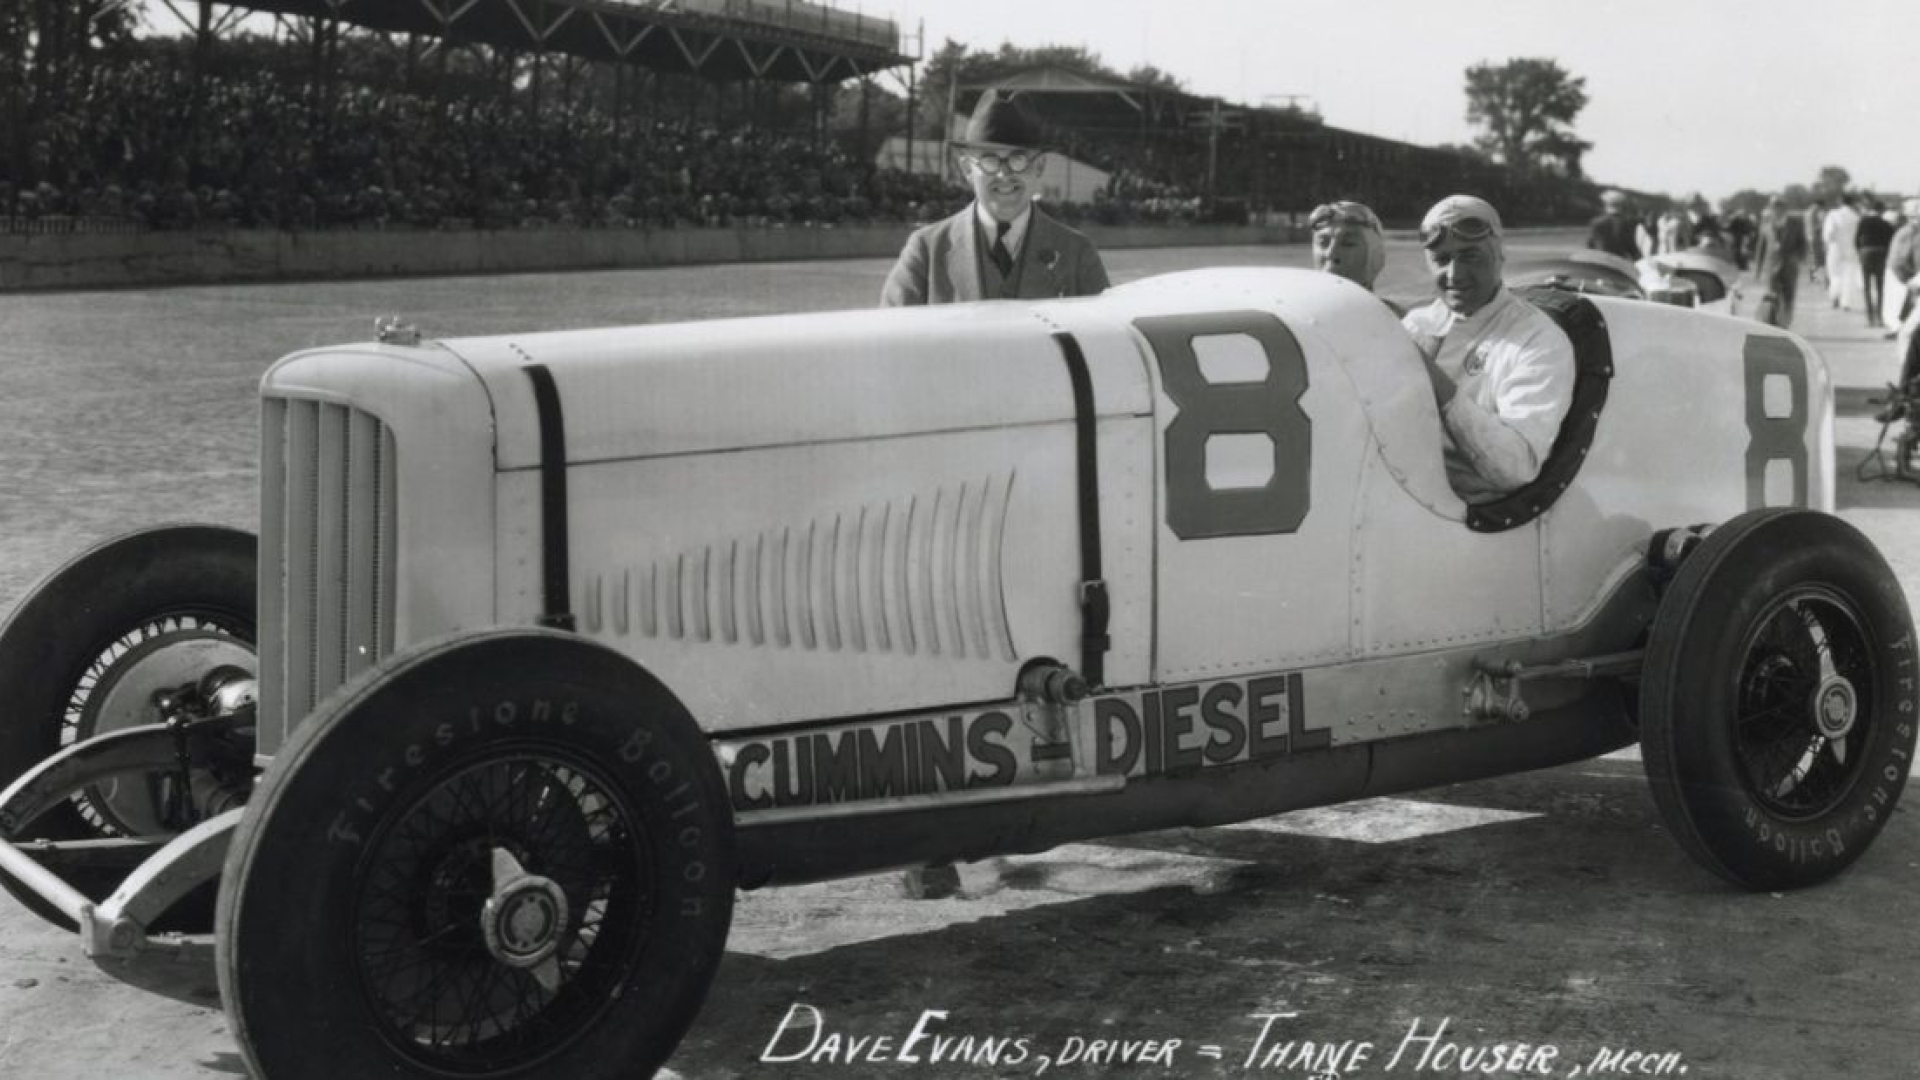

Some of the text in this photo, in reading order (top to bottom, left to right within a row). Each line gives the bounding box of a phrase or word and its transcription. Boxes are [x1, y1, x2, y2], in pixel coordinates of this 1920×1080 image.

[1131, 309, 1312, 541] 8
[1744, 334, 1808, 510] 8
[327, 698, 709, 918] Firestone Balloon
[727, 671, 1332, 810] CUMMINS DIESEL
